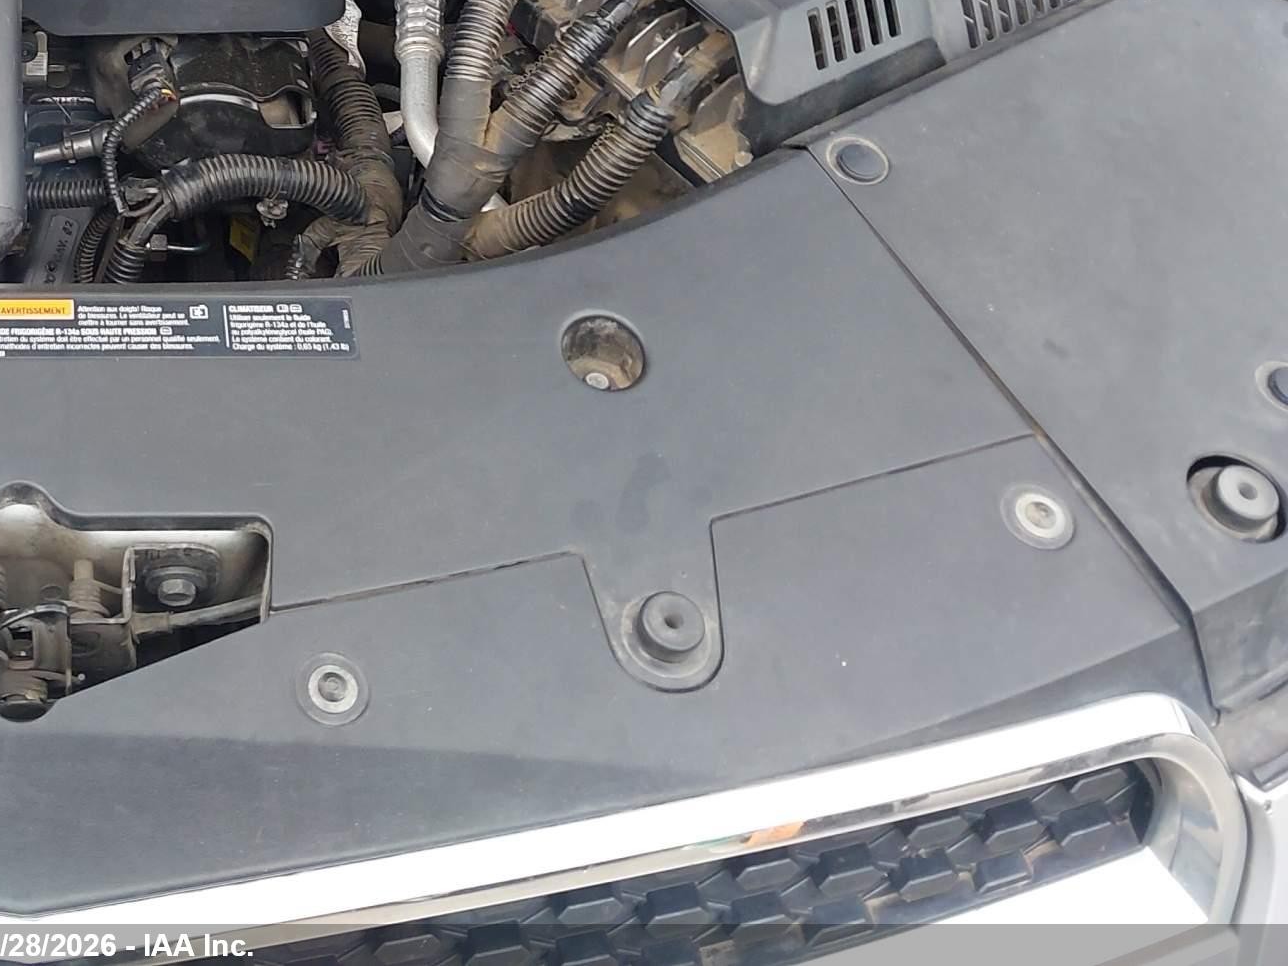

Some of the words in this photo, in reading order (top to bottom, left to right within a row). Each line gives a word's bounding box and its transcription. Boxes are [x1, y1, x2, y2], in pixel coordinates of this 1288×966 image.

[77, 305, 105, 313] Attention
[265, 321, 288, 329] R-134a
[55, 327, 80, 335] R-134a
[123, 327, 157, 335] PRESSION
[232, 343, 255, 351] Charge
